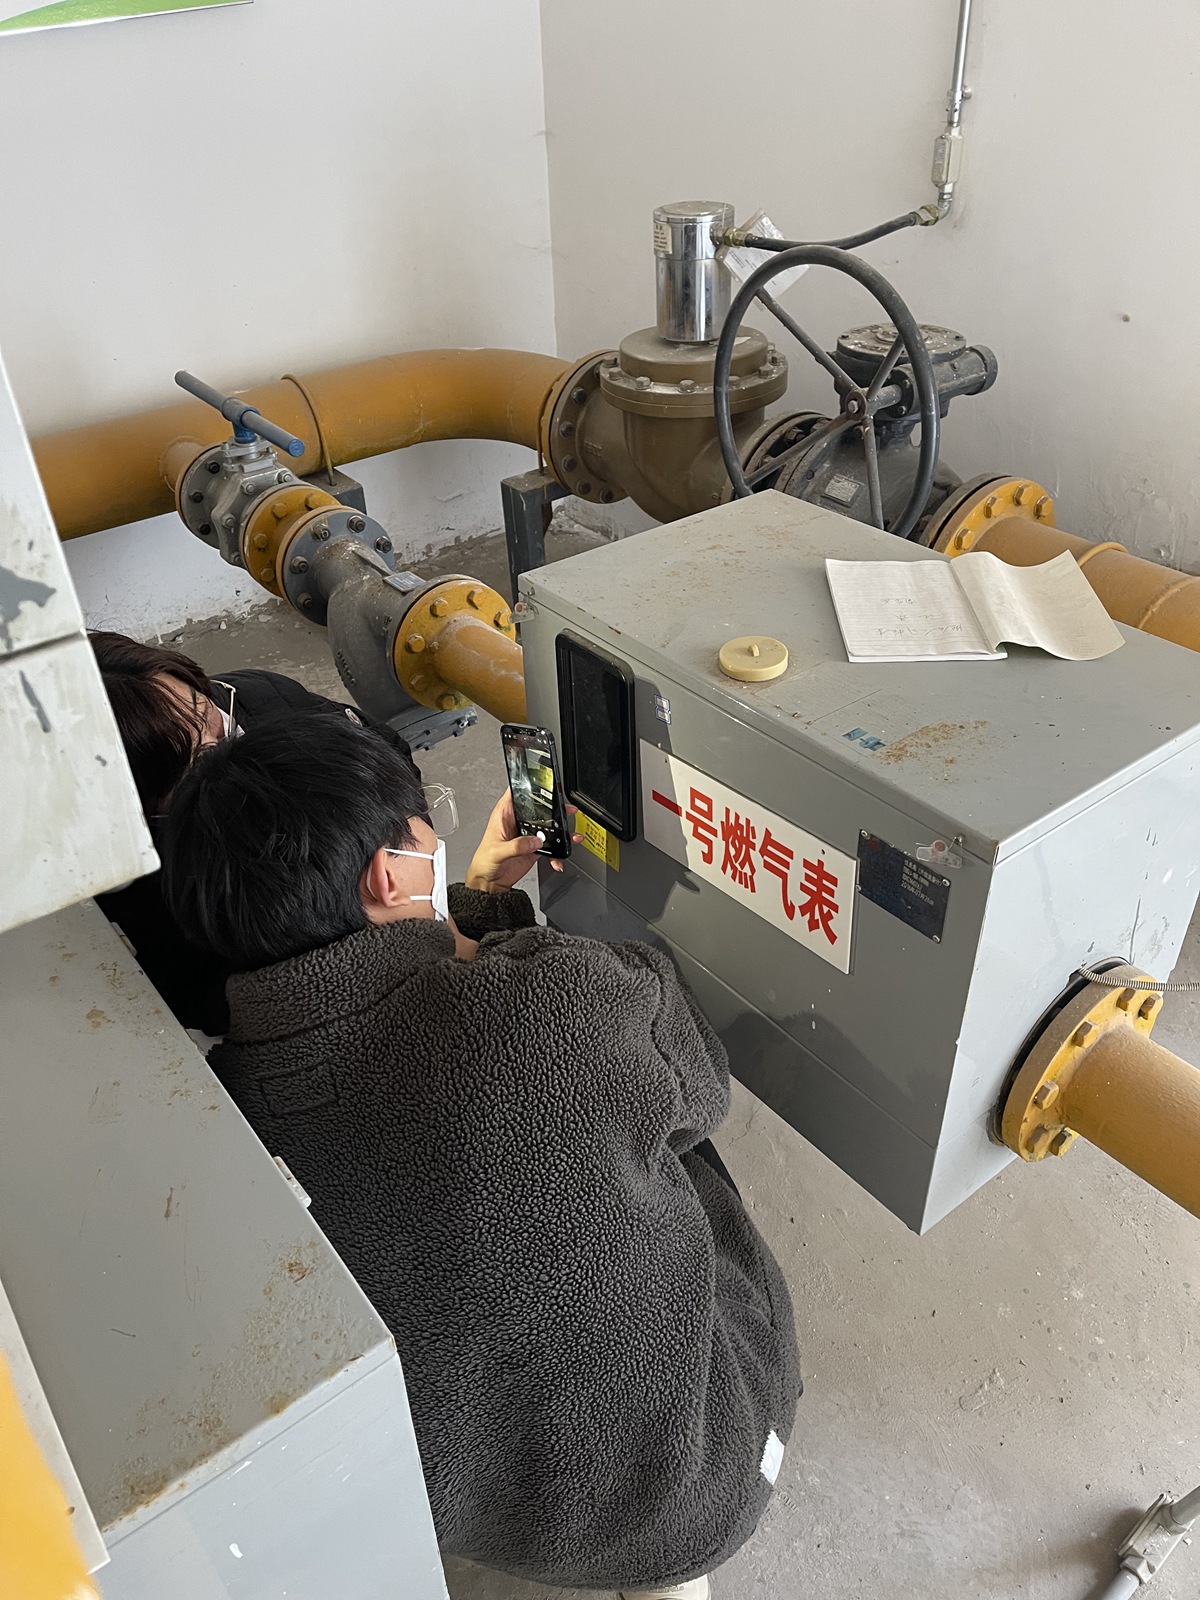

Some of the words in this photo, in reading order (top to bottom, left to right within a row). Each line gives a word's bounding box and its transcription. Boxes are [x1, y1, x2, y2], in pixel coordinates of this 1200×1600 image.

[652, 787, 839, 945] 一号燃气表
